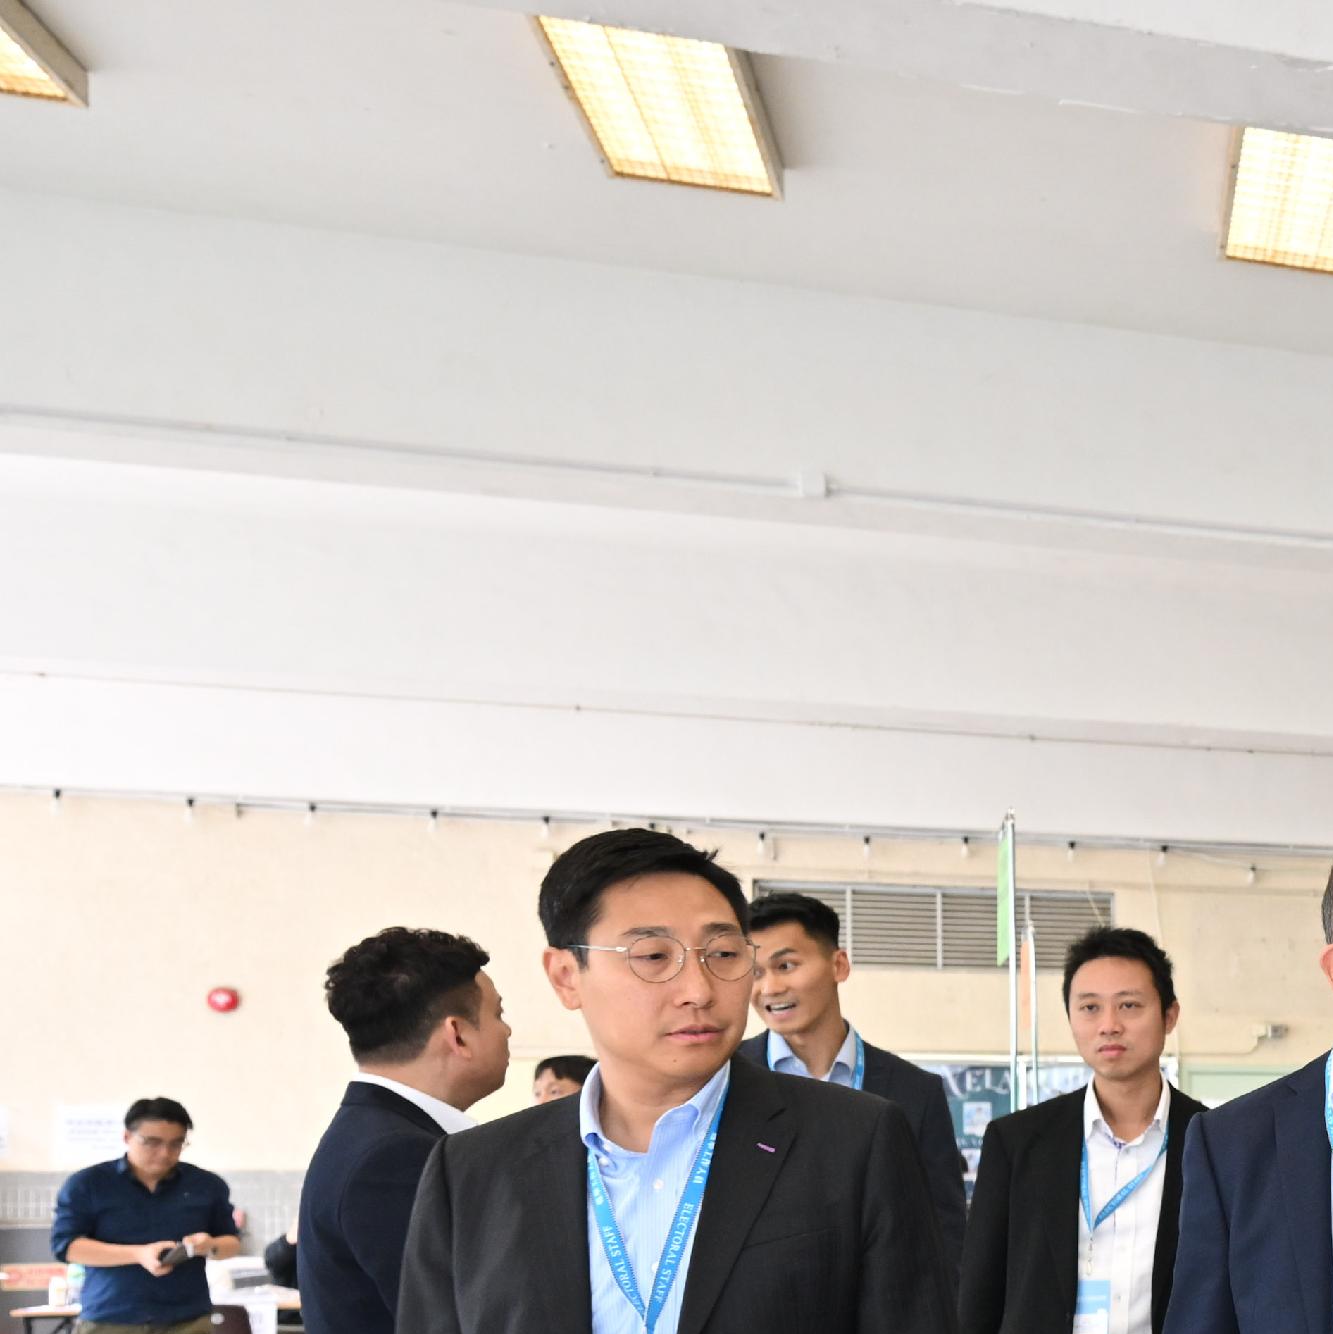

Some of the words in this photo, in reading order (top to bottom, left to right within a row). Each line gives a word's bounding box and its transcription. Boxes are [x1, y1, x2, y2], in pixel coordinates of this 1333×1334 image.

[603, 1226, 621, 1258] STAFF
[662, 1203, 694, 1266] ELECTORAL
[654, 1268, 672, 1303] STAFF
